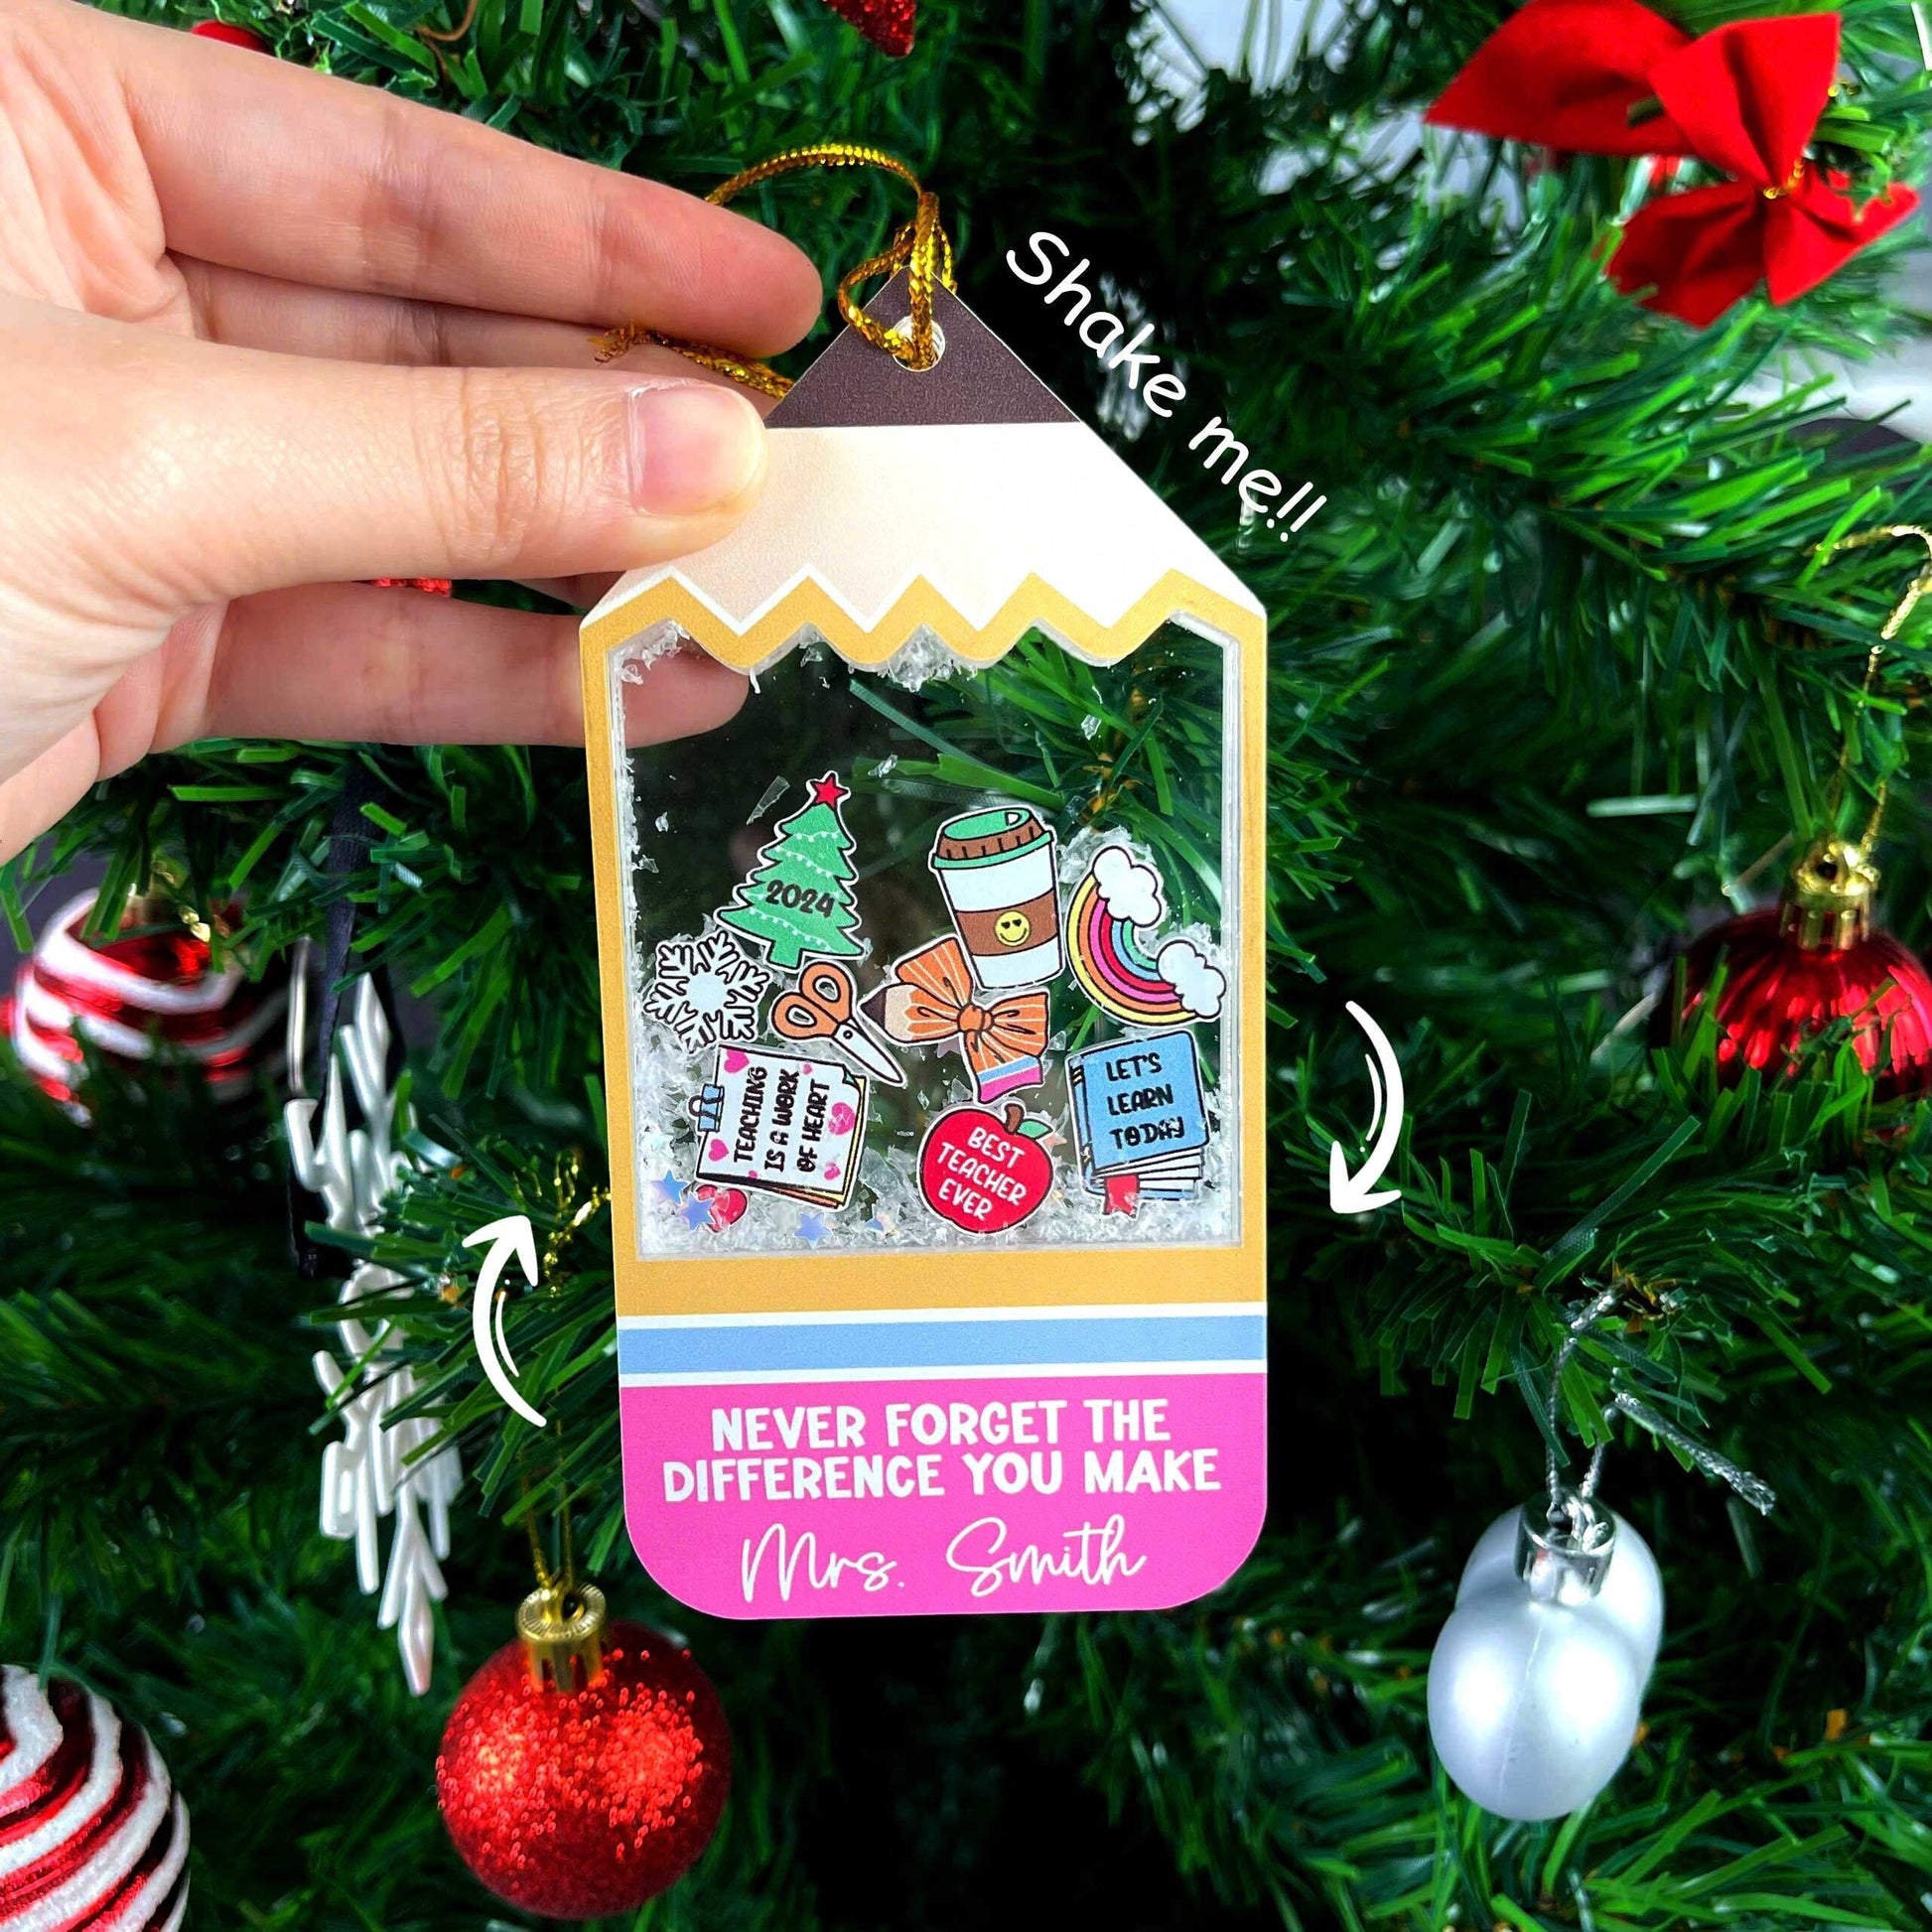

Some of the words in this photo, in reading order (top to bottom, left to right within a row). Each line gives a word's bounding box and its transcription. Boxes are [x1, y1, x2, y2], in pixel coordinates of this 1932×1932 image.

[765, 880, 835, 918] 2024
[1106, 1052, 1163, 1081] LET'S
[734, 1066, 767, 1163] TEACHING
[771, 1069, 799, 1126] WORK
[801, 1079, 830, 1141] HEART
[1107, 1084, 1173, 1116] LEARN
[769, 1131, 789, 1146] A
[968, 1126, 1026, 1169] BEST
[1110, 1116, 1184, 1149] TODAY
[764, 1149, 786, 1173] IS
[797, 1145, 818, 1173] OF
[937, 1142, 1027, 1206] TEACHER
[938, 1177, 993, 1221] EVER
[711, 1406, 866, 1451] NEVER
[886, 1400, 1066, 1448] FORGET
[1083, 1398, 1172, 1443] THE
[663, 1453, 945, 1503] DIFFERENCE
[962, 1449, 1063, 1496] YOU
[1083, 1448, 1221, 1494] MAKE
[741, 1523, 905, 1602] Mrs.
[945, 1514, 1148, 1596] Smith
